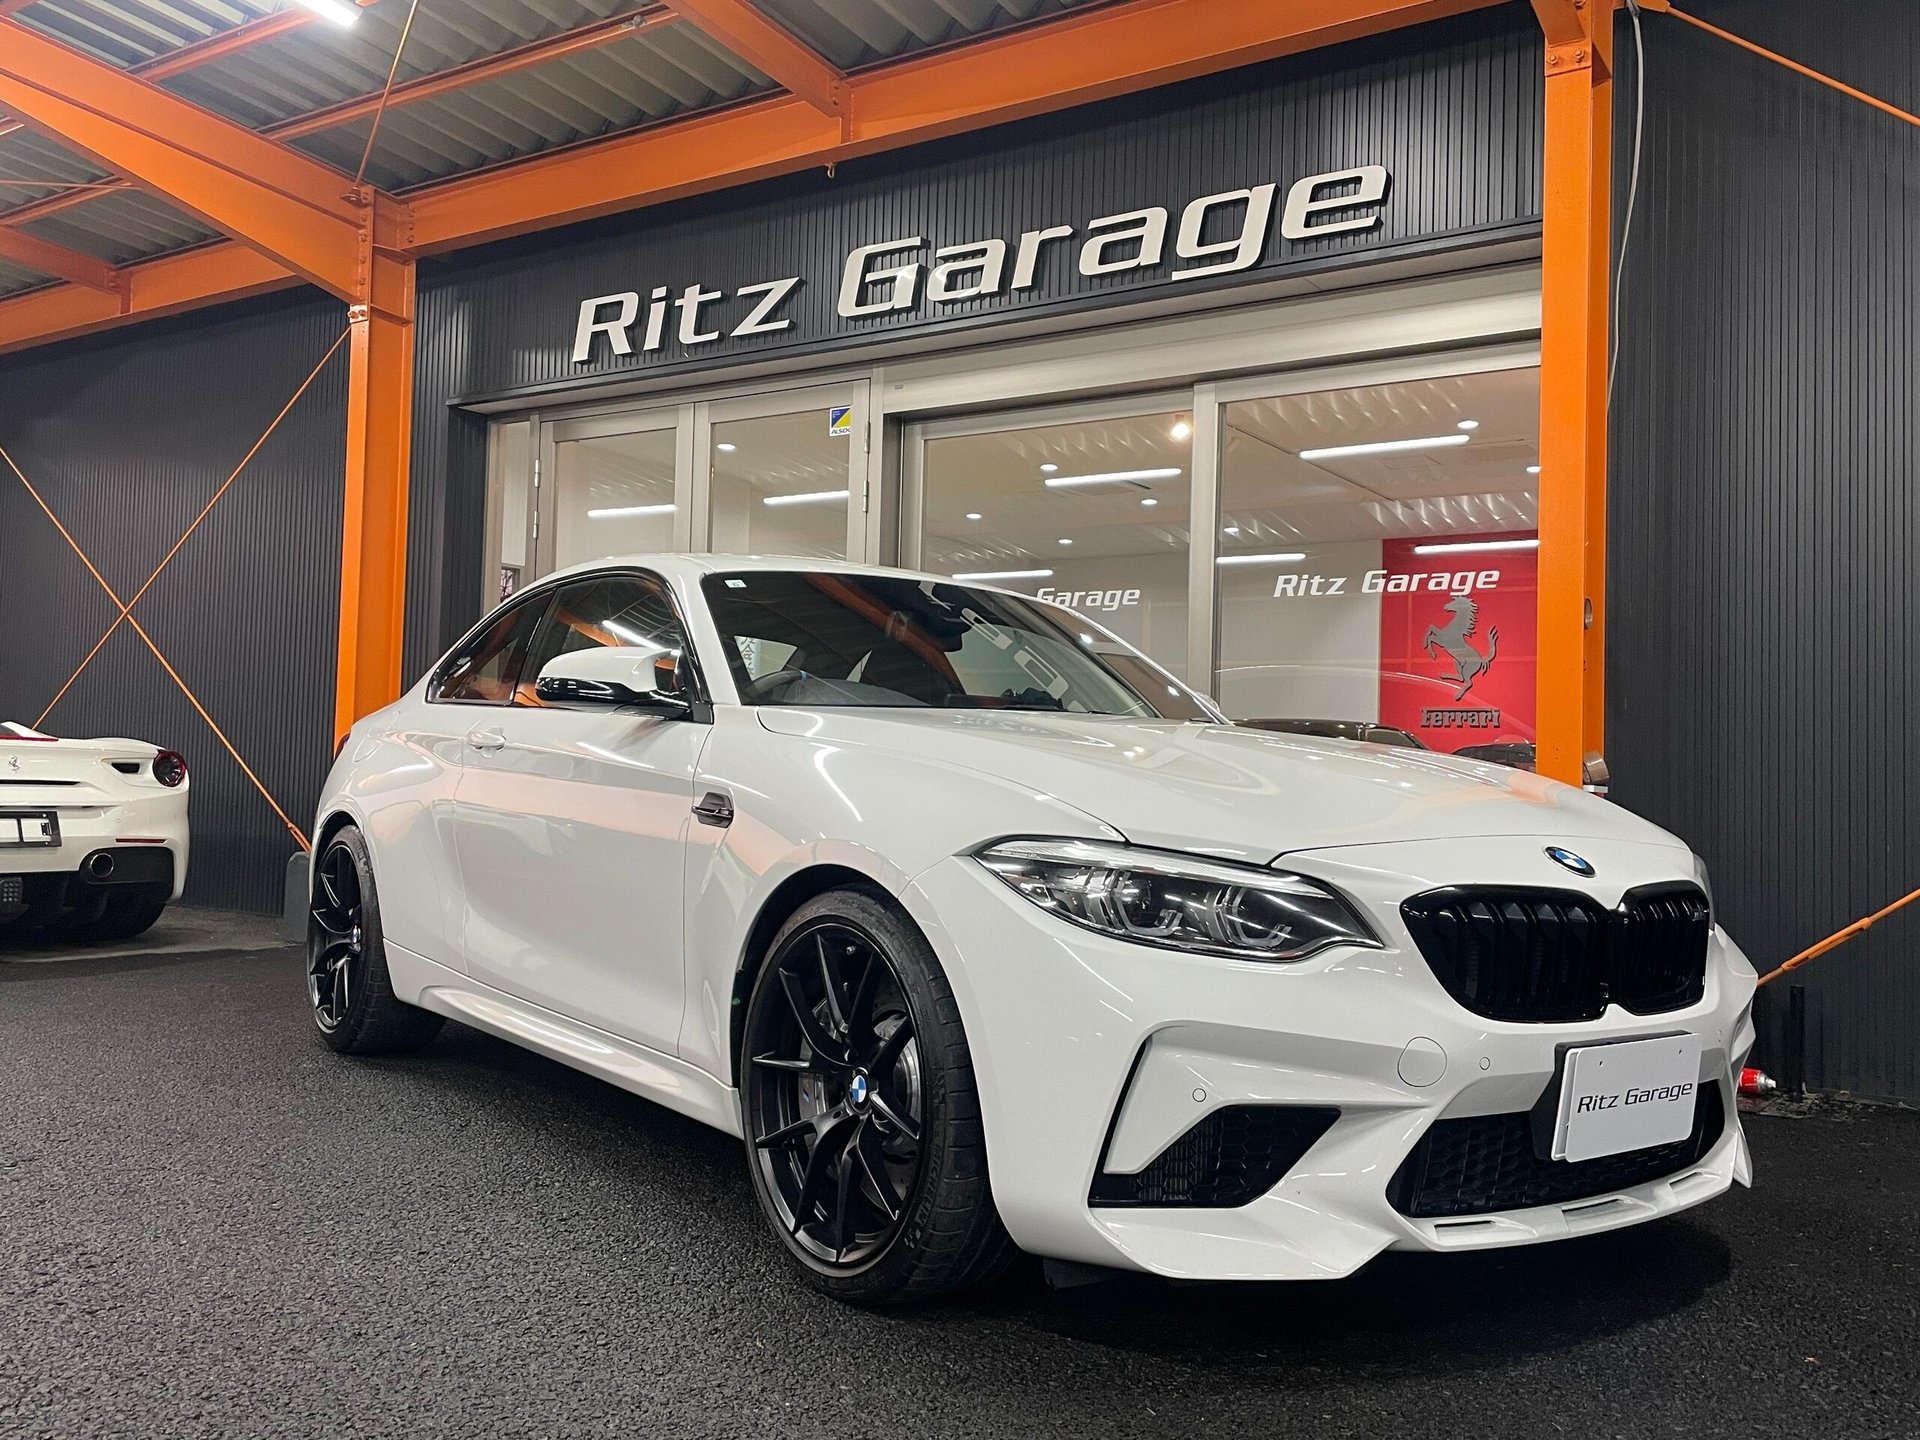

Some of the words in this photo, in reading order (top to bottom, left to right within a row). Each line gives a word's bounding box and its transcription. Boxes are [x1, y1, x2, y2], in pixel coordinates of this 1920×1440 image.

[572, 276, 802, 363] Ritz
[837, 164, 1389, 317] Garage
[1272, 573, 1348, 598] Ritz
[1361, 569, 1501, 596] Garage
[1036, 587, 1141, 612] Garage
[1420, 708, 1501, 728] Ferrari
[1576, 1094, 1620, 1113] Ritz
[1624, 1082, 1693, 1106] Garage
